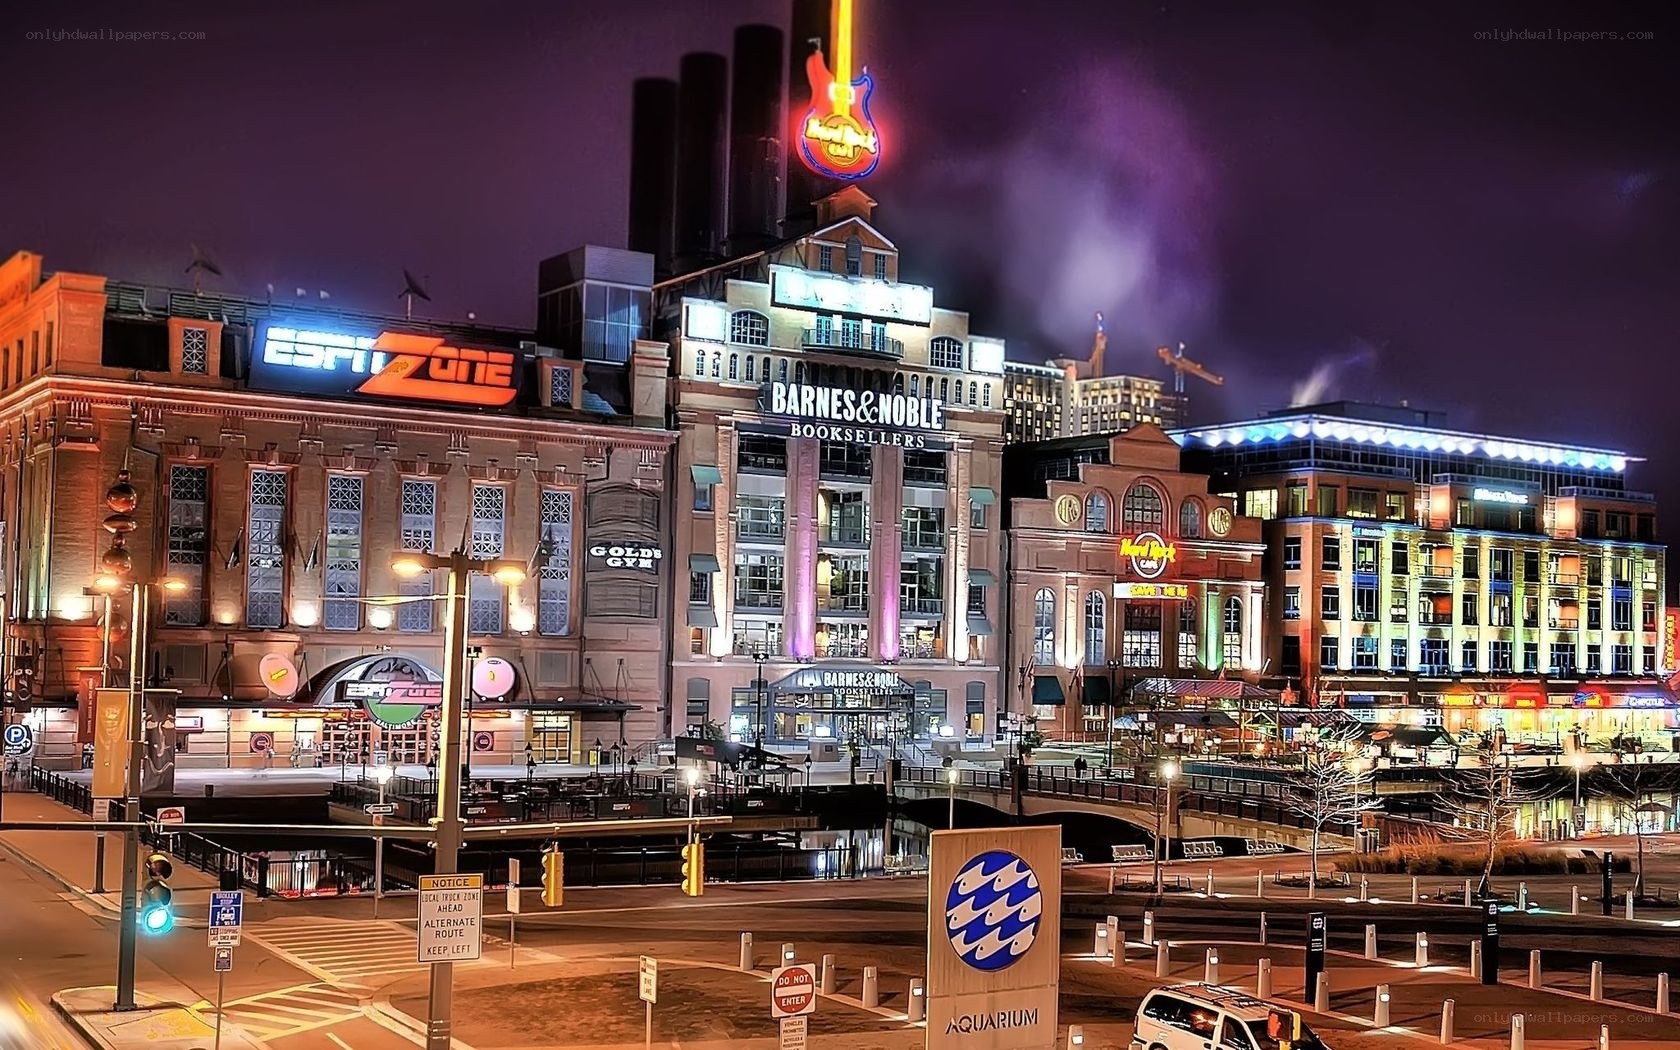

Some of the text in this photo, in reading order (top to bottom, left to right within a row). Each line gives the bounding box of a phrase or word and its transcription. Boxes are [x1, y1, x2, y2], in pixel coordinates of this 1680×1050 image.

[790, 422, 925, 448] BOOKSELLERS
[606, 557, 653, 568] GYM
[432, 878, 470, 888] NOTICE
[421, 891, 479, 902] LOCAL TRUCK ZONE
[437, 904, 463, 913] AHEAD
[424, 918, 475, 928] ALTERNATE
[435, 929, 464, 938] ROUTE
[427, 945, 470, 955] KEEP LEFT
[779, 975, 808, 986] DO NOT
[781, 996, 806, 1006] ENTER
[945, 1007, 1038, 1035] AQUARIUM
